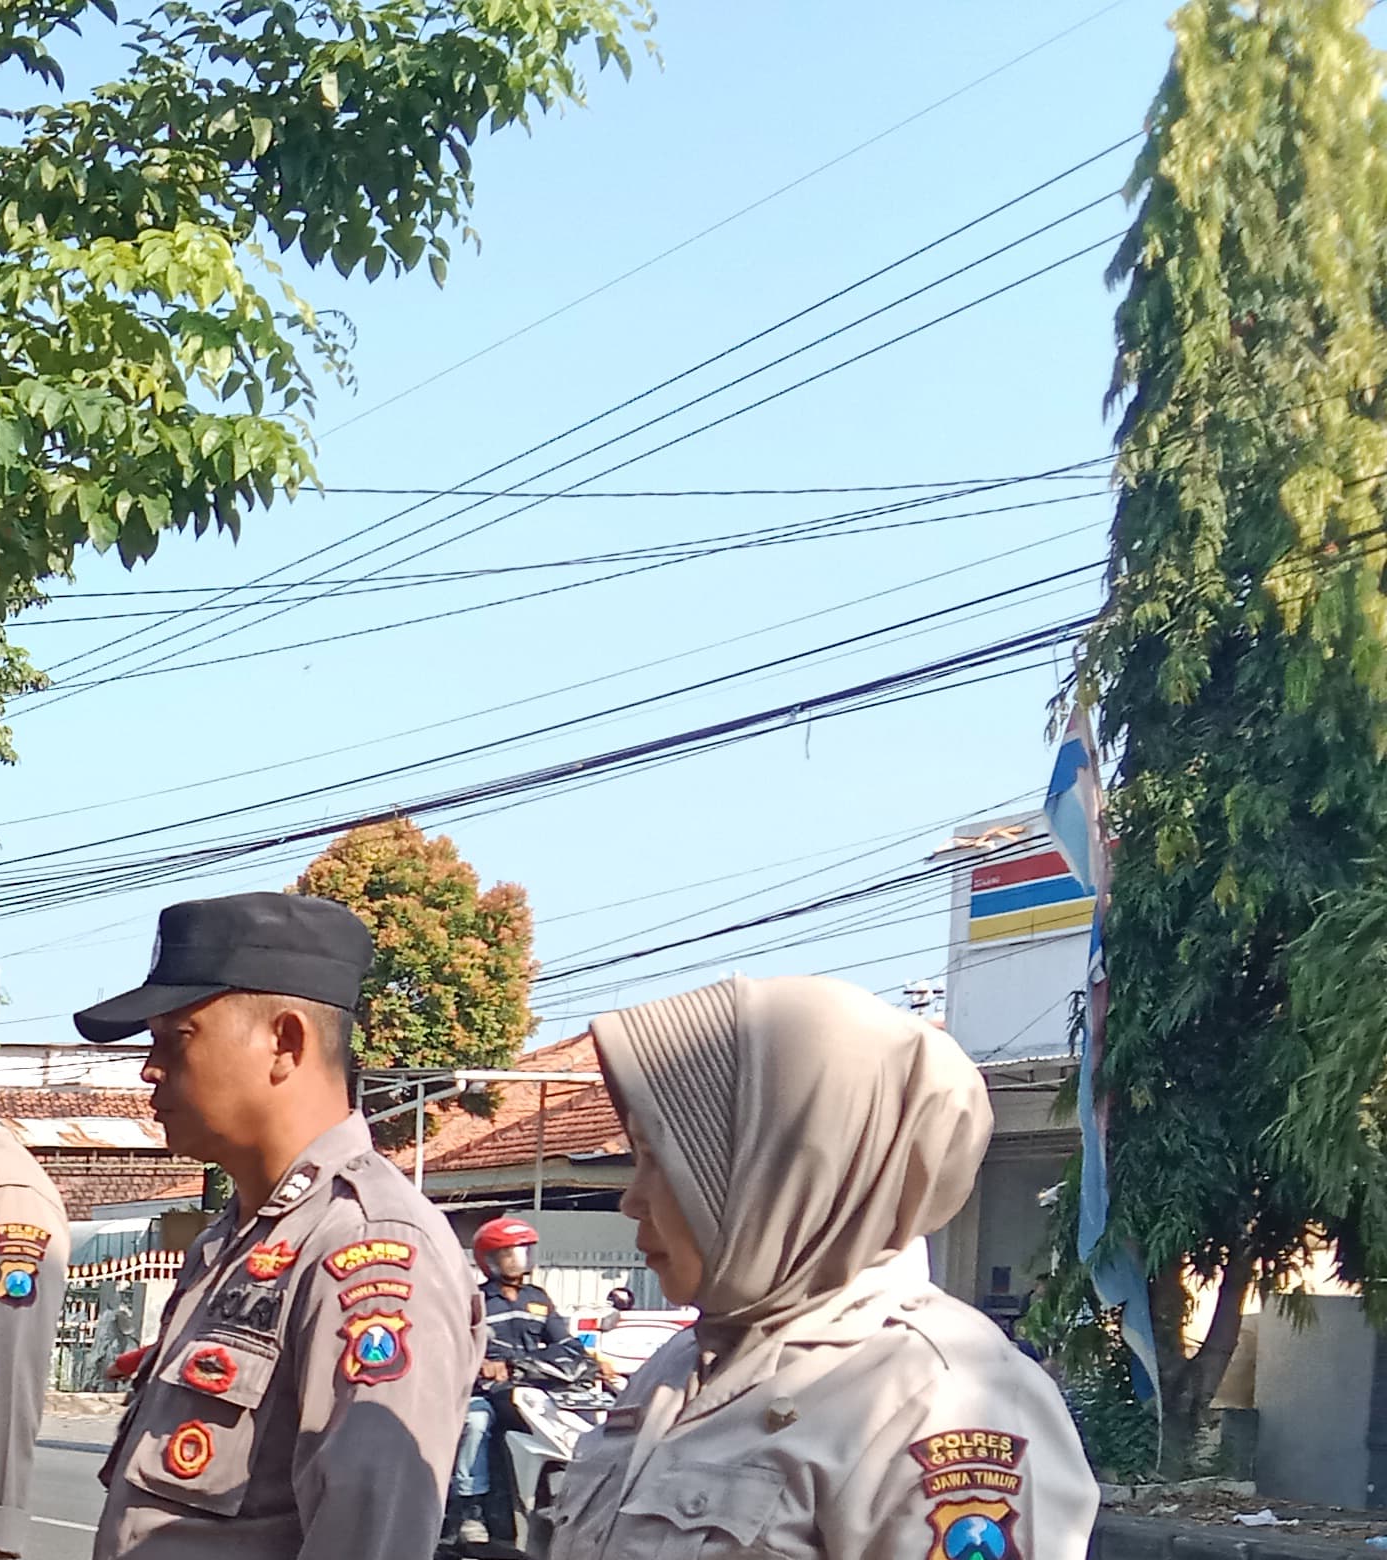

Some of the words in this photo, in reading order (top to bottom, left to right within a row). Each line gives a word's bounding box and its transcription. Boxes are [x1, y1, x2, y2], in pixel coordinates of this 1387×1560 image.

[334, 1242, 410, 1269] POLRES
[929, 1432, 1013, 1455] POLRES
[931, 1446, 1015, 1466] GRESIK
[932, 1472, 971, 1491] JAWA
[974, 1471, 1018, 1490] TIMUR
